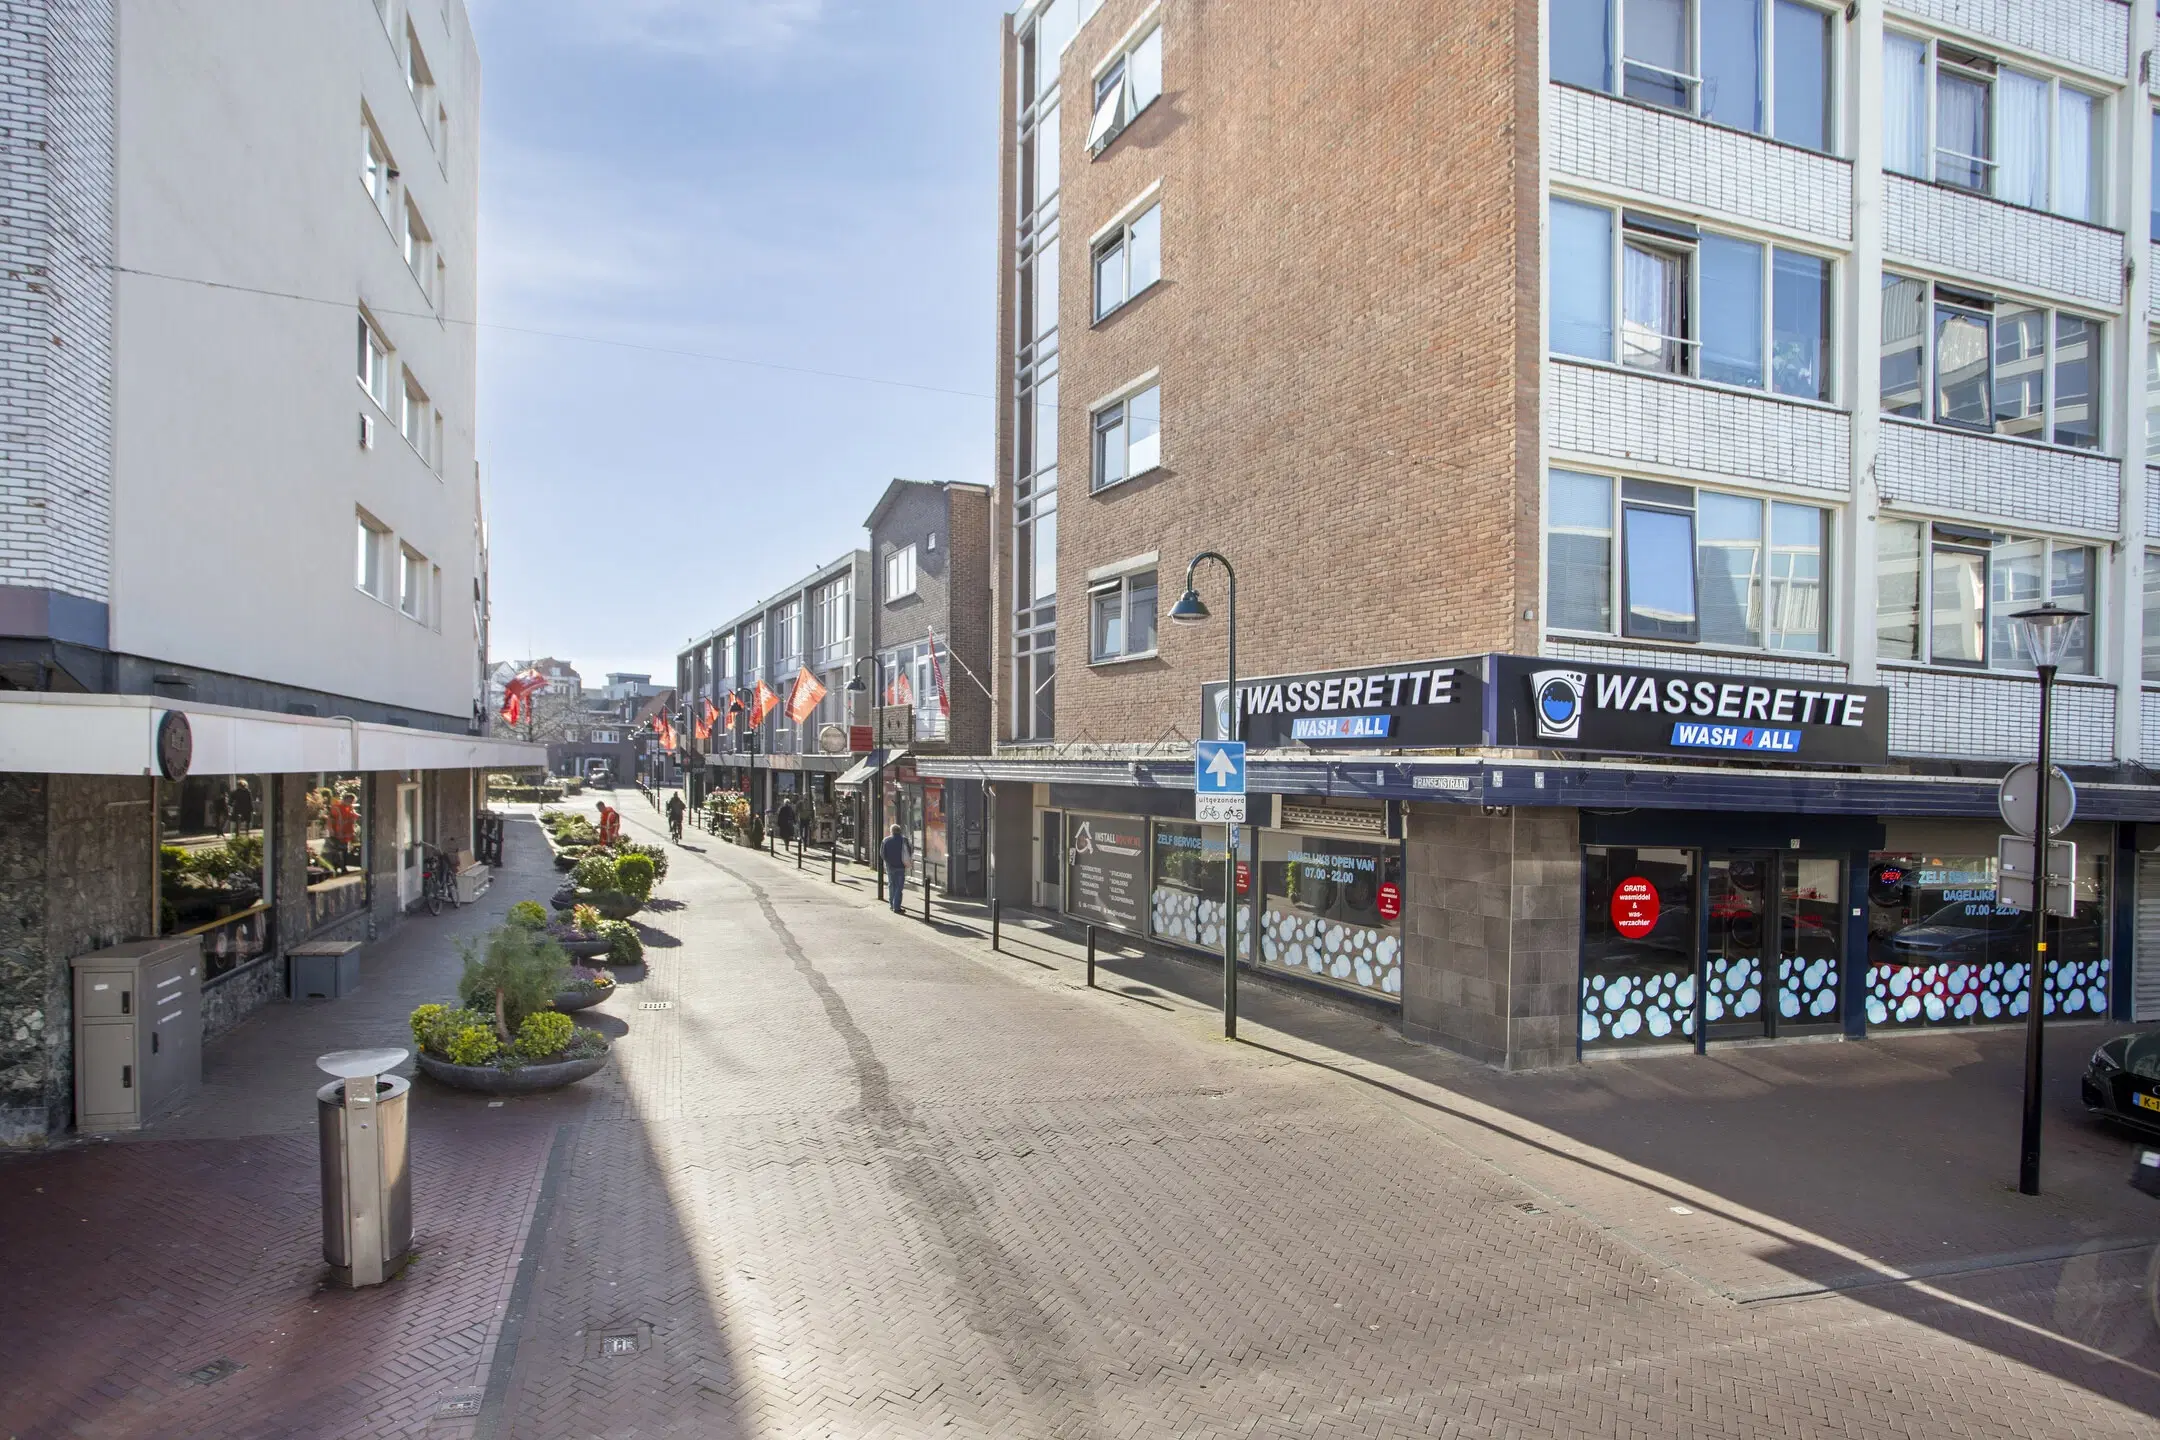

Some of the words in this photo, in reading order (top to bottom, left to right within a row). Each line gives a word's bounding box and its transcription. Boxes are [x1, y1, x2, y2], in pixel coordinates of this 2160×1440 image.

[1247, 668, 1455, 715] WASSERETTE
[1596, 673, 1867, 728] WASSERETTE
[1296, 720, 1337, 737] WASH
[1340, 719, 1350, 735] 4
[1353, 717, 1384, 735] ALL
[1679, 725, 1738, 746] WASH
[1742, 729, 1754, 747] 4
[1758, 730, 1794, 750] ALL
[1414, 777, 1468, 789] FRANSENSTRAAT
[1199, 796, 1245, 804] uitgezonderd
[1157, 833, 1173, 845] ZELF
[1173, 835, 1201, 849] SERVICE
[1287, 850, 1330, 866] DAGELIJKS
[1331, 855, 1355, 870] OPEN
[1355, 858, 1375, 872] VAN
[1304, 866, 1326, 880] 07.00
[1331, 869, 1354, 883] 22.00
[1881, 871, 1902, 881] OPEN
[1918, 870, 1946, 884] ZELF
[1943, 889, 1995, 901] DAGELIJKS
[1632, 901, 1638, 909] &
[1965, 904, 1990, 915] 07.00
